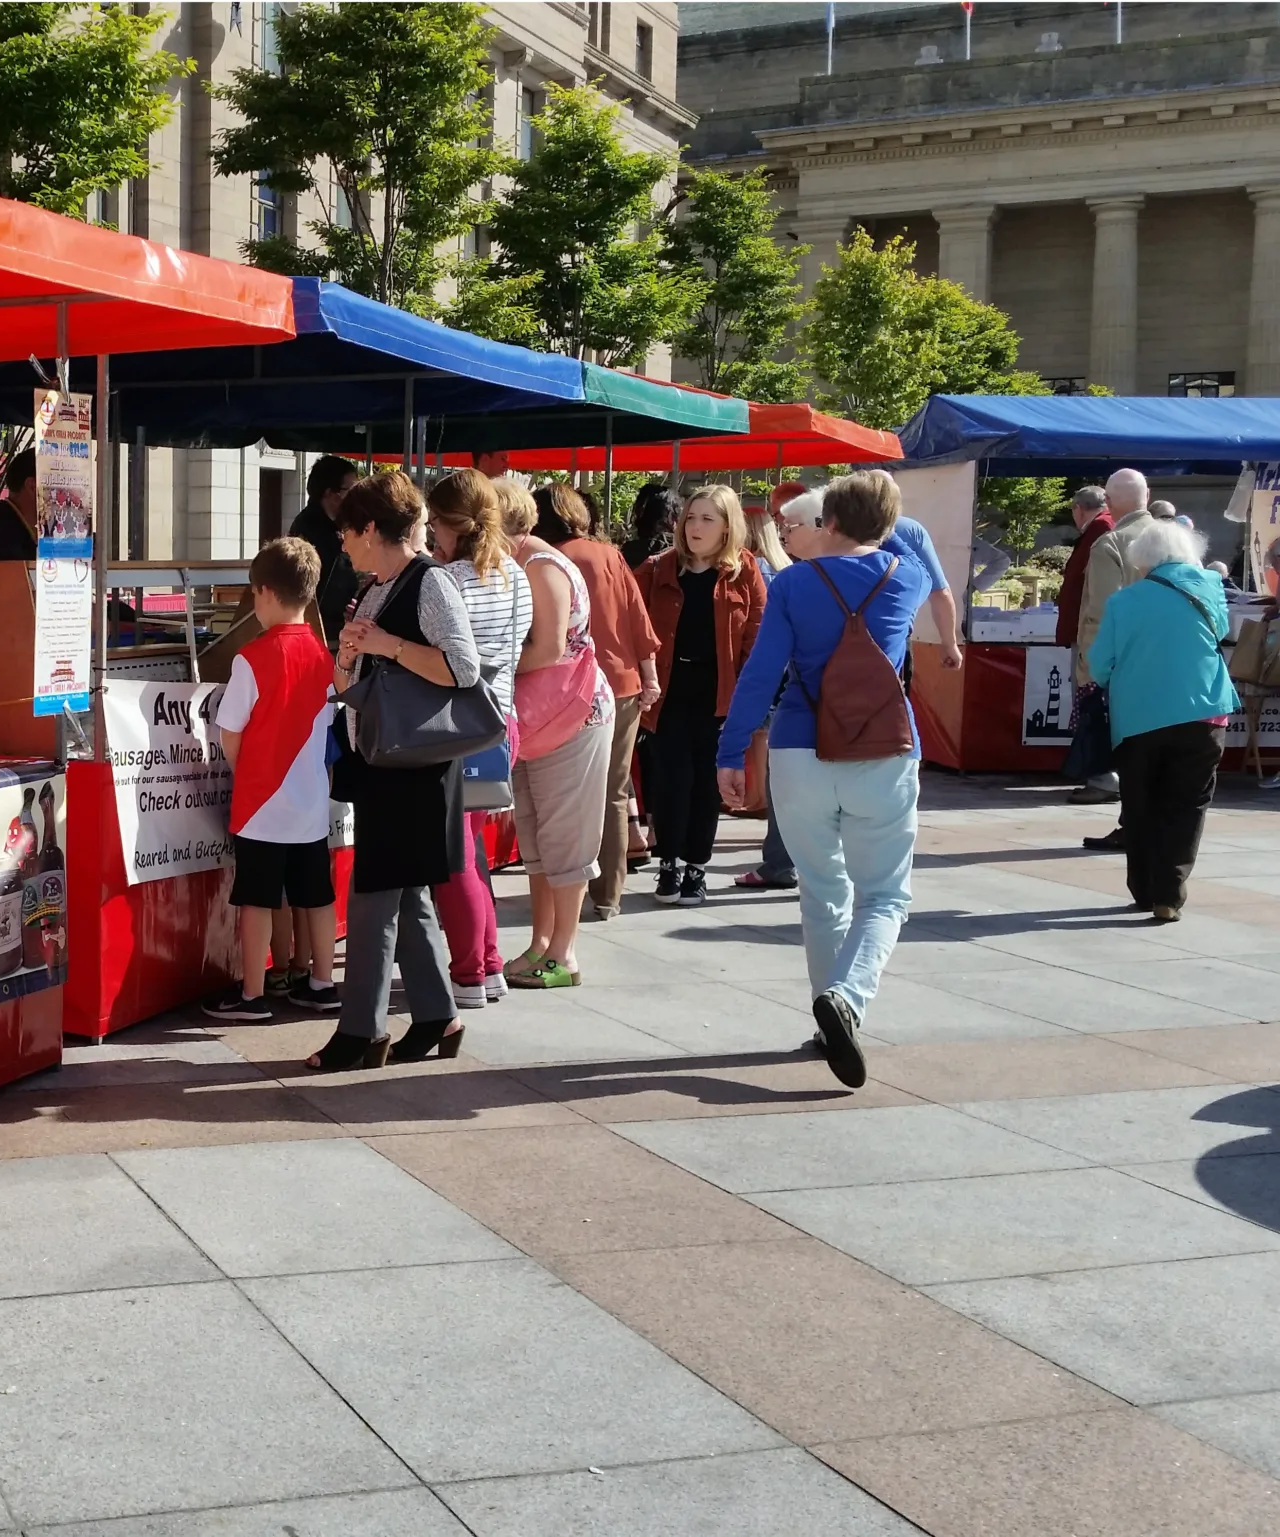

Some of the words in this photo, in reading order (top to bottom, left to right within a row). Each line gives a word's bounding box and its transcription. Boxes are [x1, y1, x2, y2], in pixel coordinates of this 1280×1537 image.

[154, 691, 192, 734] Any
[199, 688, 217, 725] 4
[139, 790, 181, 812] Check
[185, 789, 203, 808] out
[135, 843, 170, 869] Reared
[173, 840, 191, 862] and
